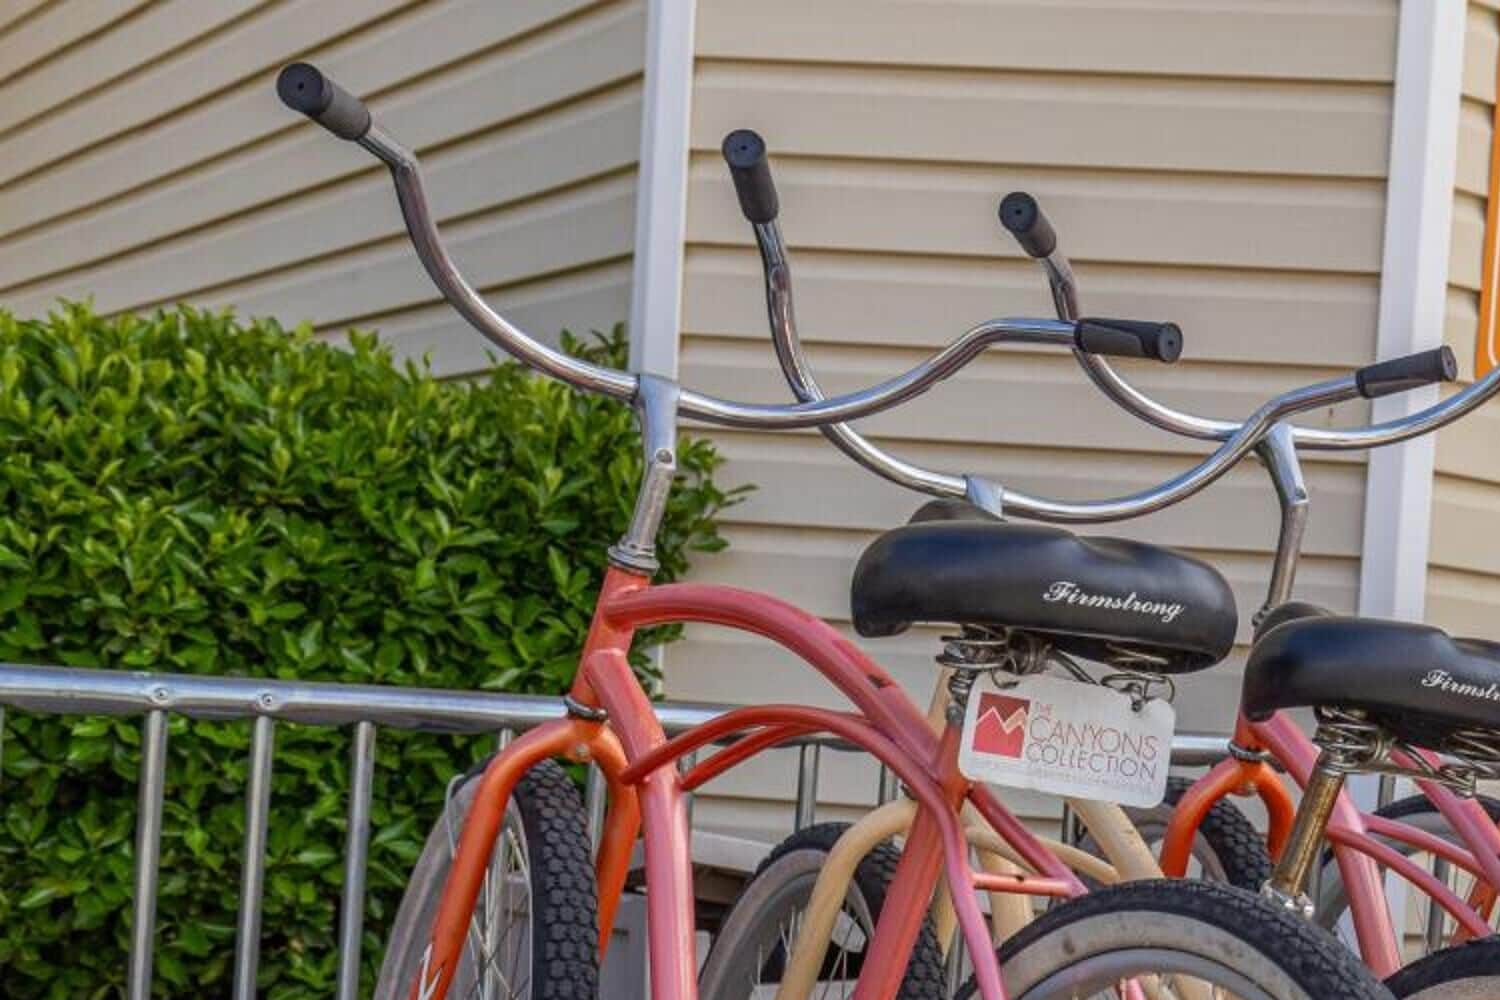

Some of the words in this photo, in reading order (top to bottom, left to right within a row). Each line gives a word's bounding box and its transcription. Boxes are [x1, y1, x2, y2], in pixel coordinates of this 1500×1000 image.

[1043, 580, 1185, 623] Firmstrong
[1030, 717, 1159, 761] CANYONS
[1025, 741, 1158, 781] COLLECTION
